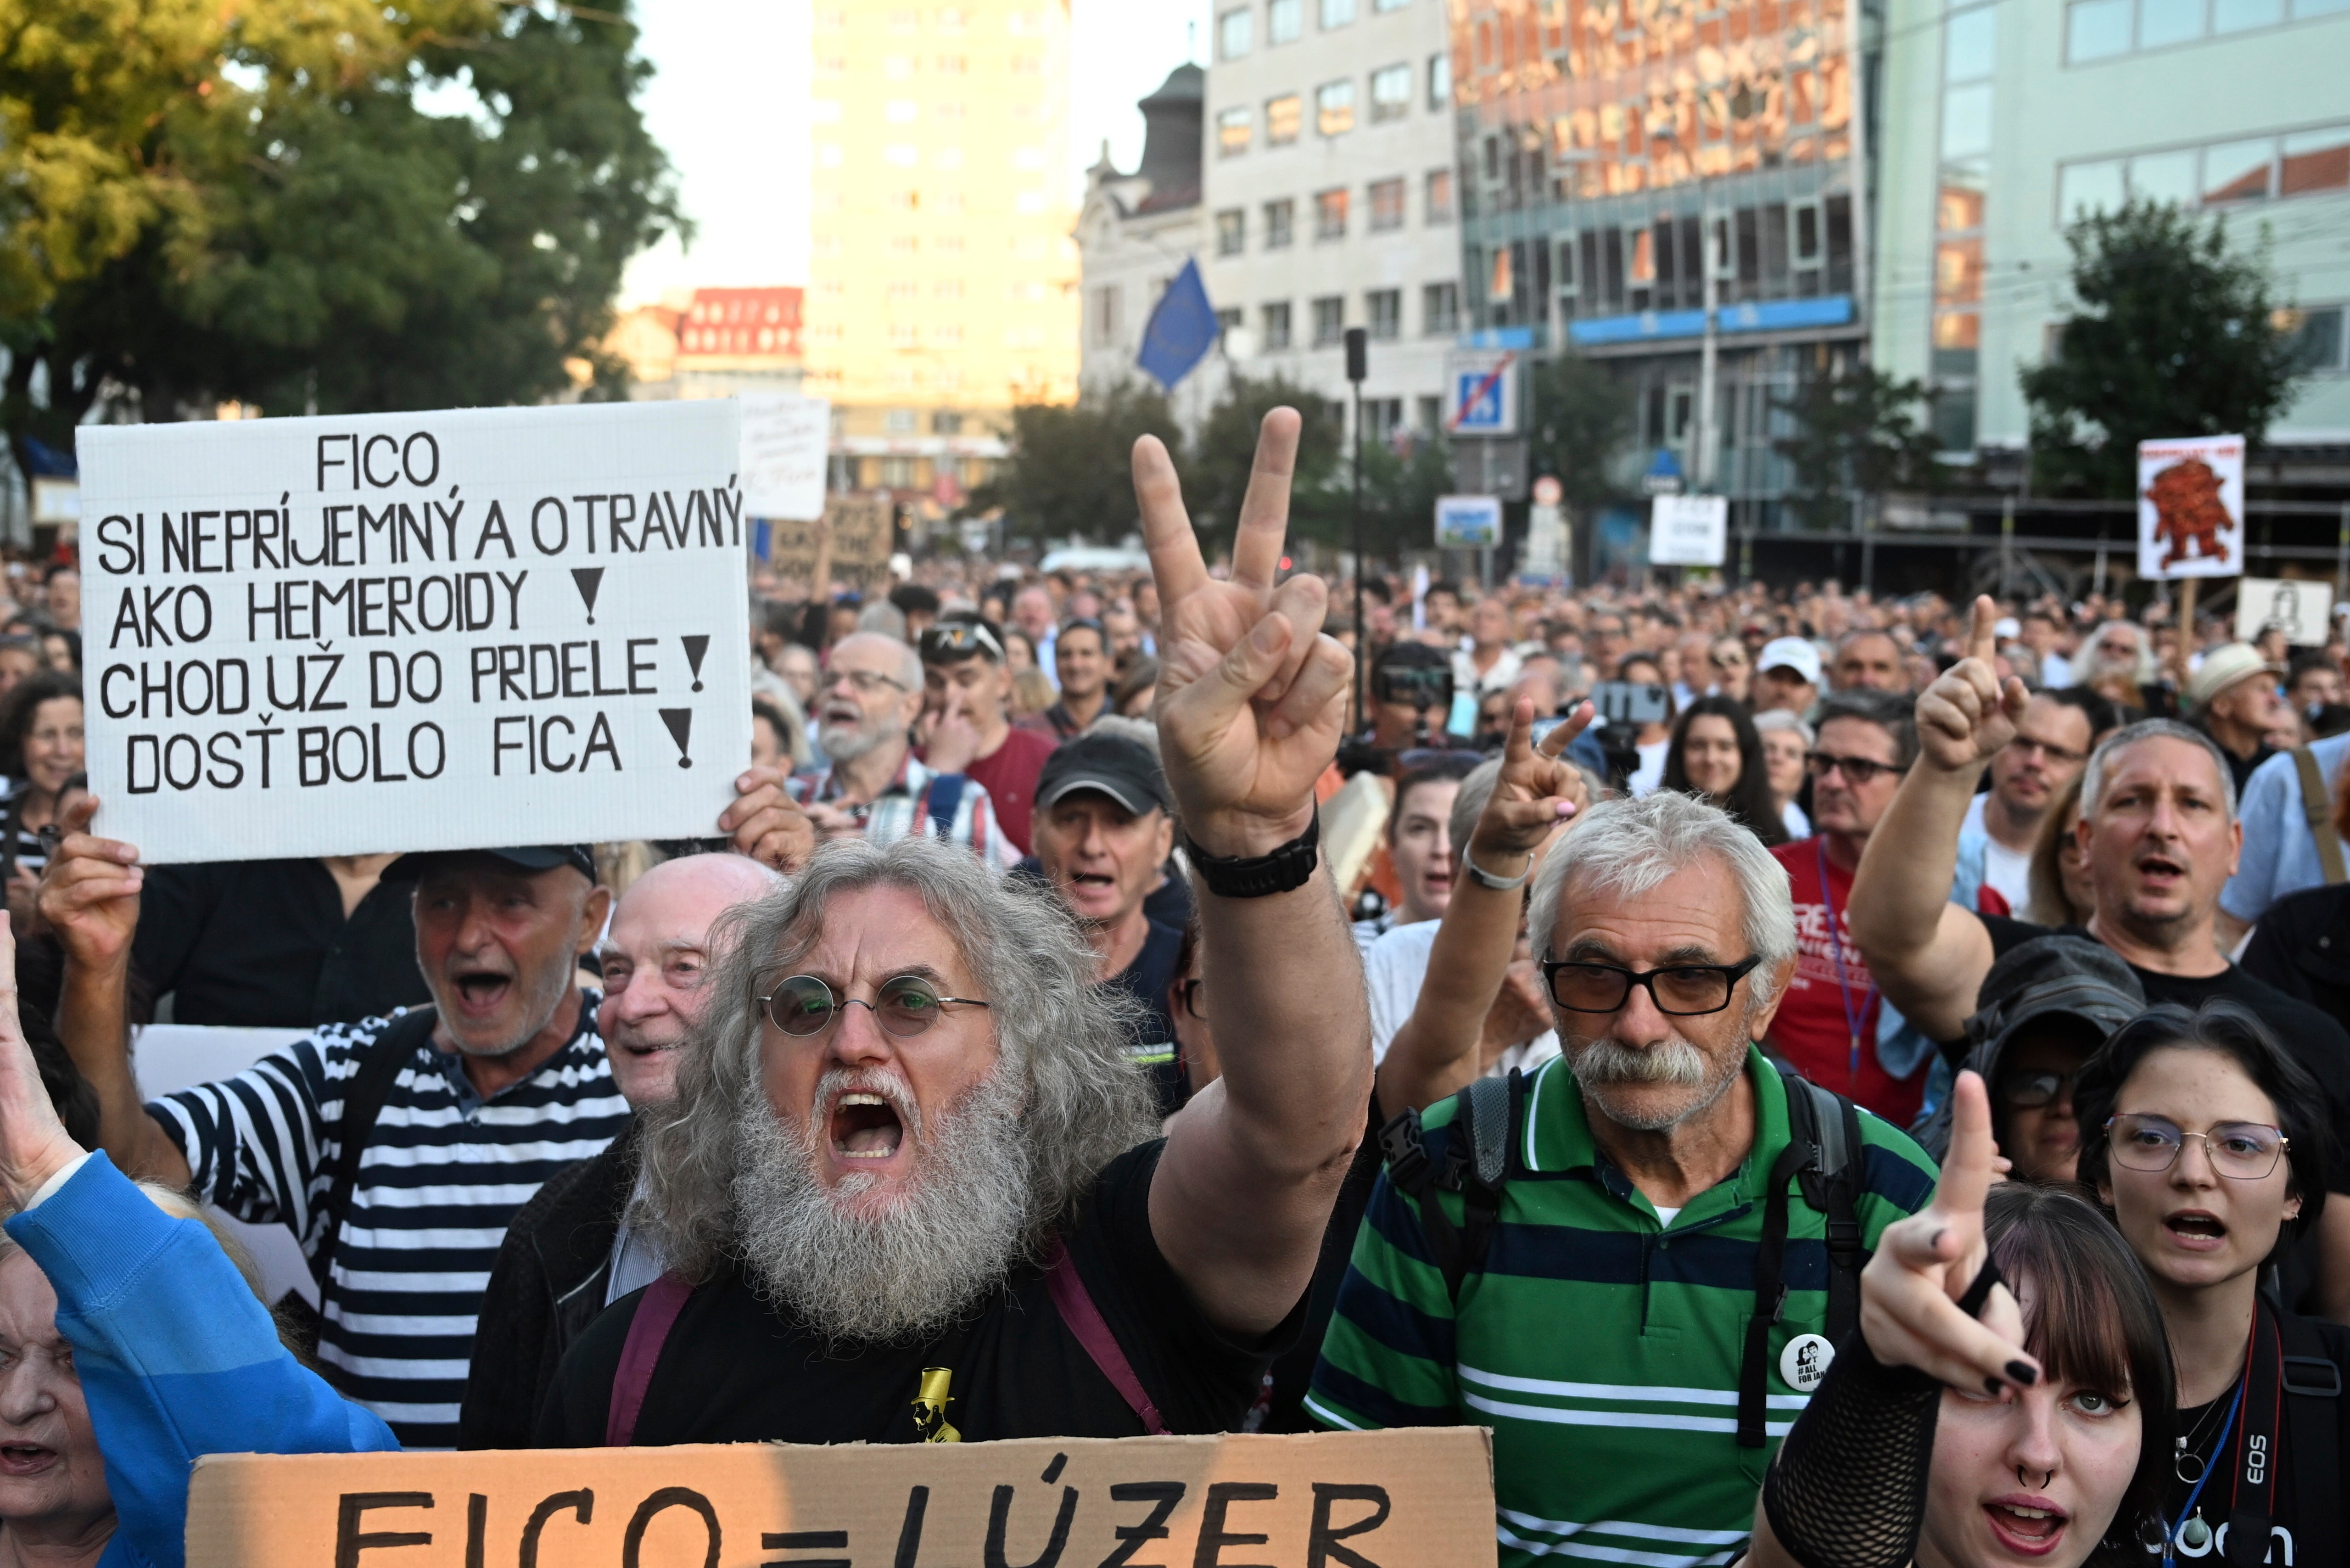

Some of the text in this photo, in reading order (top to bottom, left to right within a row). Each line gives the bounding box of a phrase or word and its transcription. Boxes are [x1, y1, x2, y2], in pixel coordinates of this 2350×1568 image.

[318, 431, 439, 492] FICO
[97, 474, 743, 575] SI NEPRÍJEMNÝ A OTRAVNÝ
[109, 584, 212, 649] AKO
[248, 570, 528, 642] HEMEROIDY
[101, 658, 249, 719] CHOD
[266, 640, 347, 711] UŽ
[369, 650, 442, 708] DO
[471, 638, 658, 703] PRDELE
[127, 713, 285, 795] DOSŤ
[297, 721, 445, 787] BOLO
[494, 711, 622, 776] FICA
[1798, 1374, 1812, 1384] FOR
[2247, 1434, 2266, 1484] EOS
